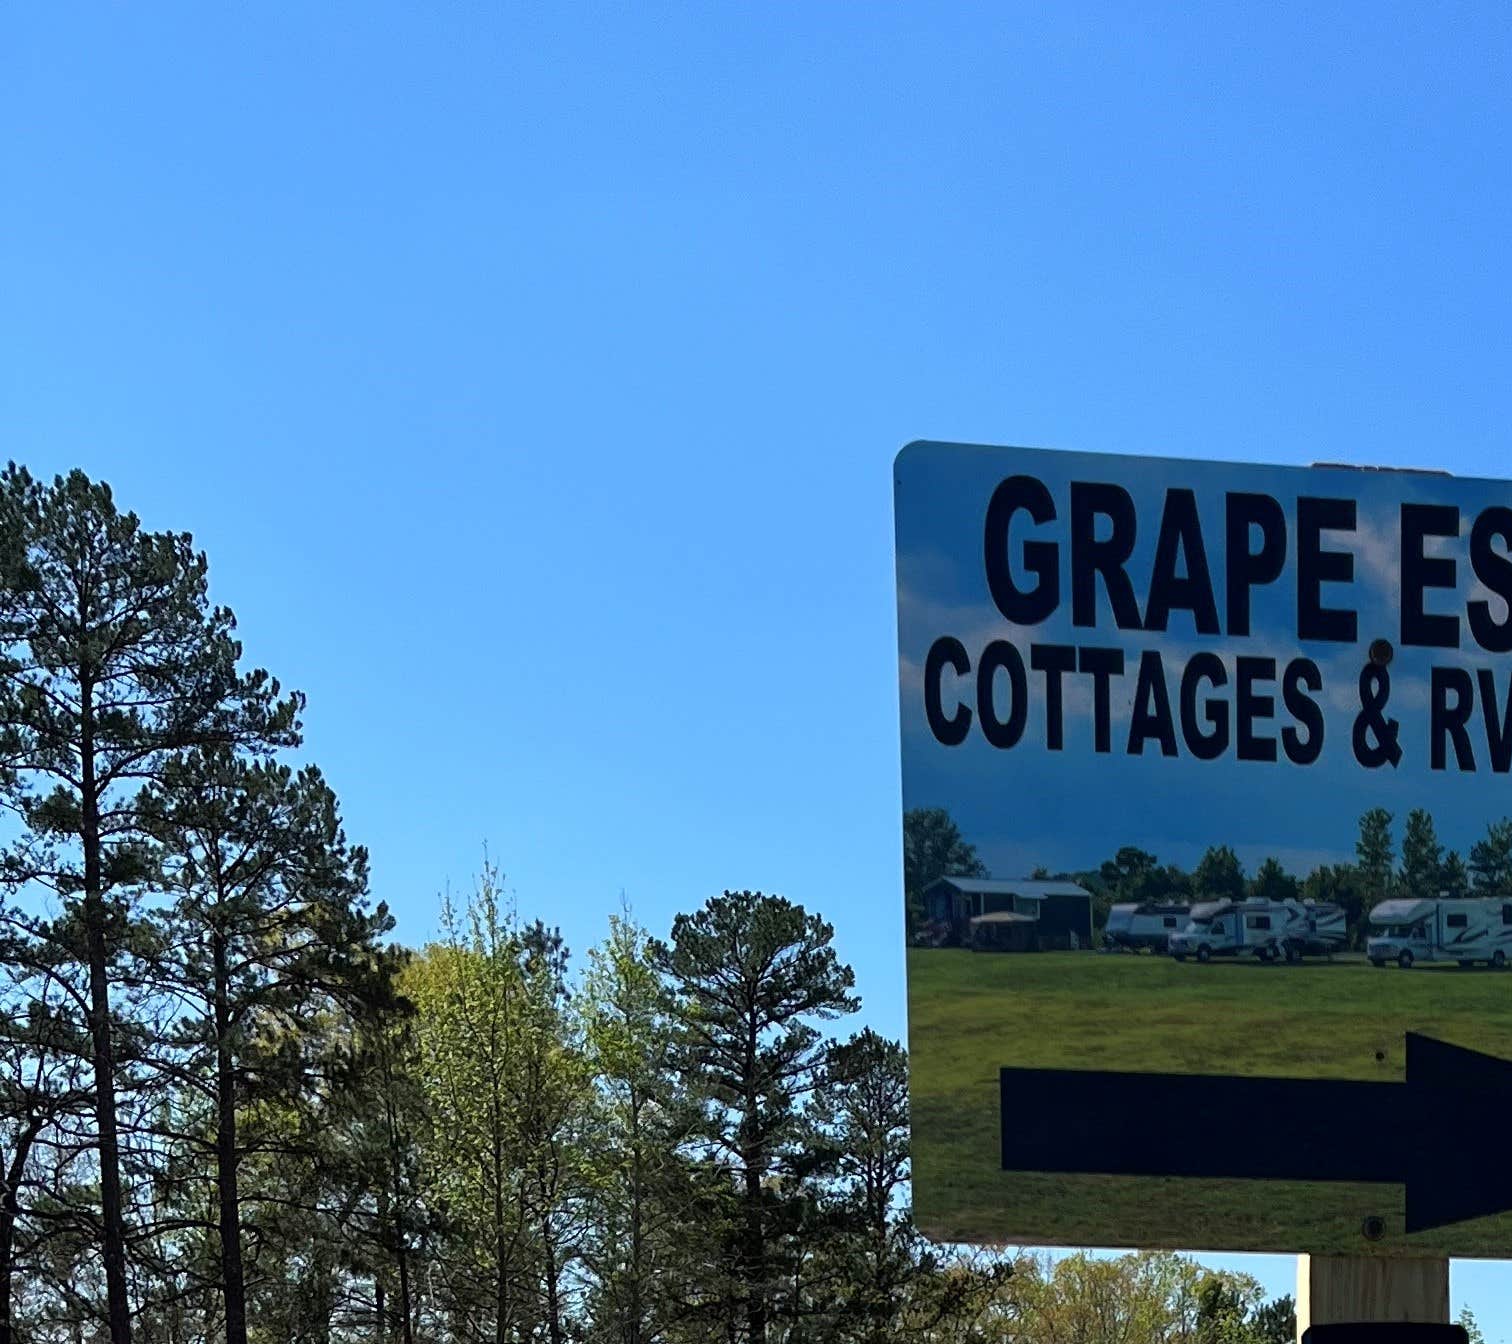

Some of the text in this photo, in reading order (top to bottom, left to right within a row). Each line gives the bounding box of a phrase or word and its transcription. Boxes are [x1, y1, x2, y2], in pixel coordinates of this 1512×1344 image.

[983, 474, 1358, 644] GRAPE
[923, 636, 1324, 765] COTTAGES
[1352, 664, 1400, 768] &
